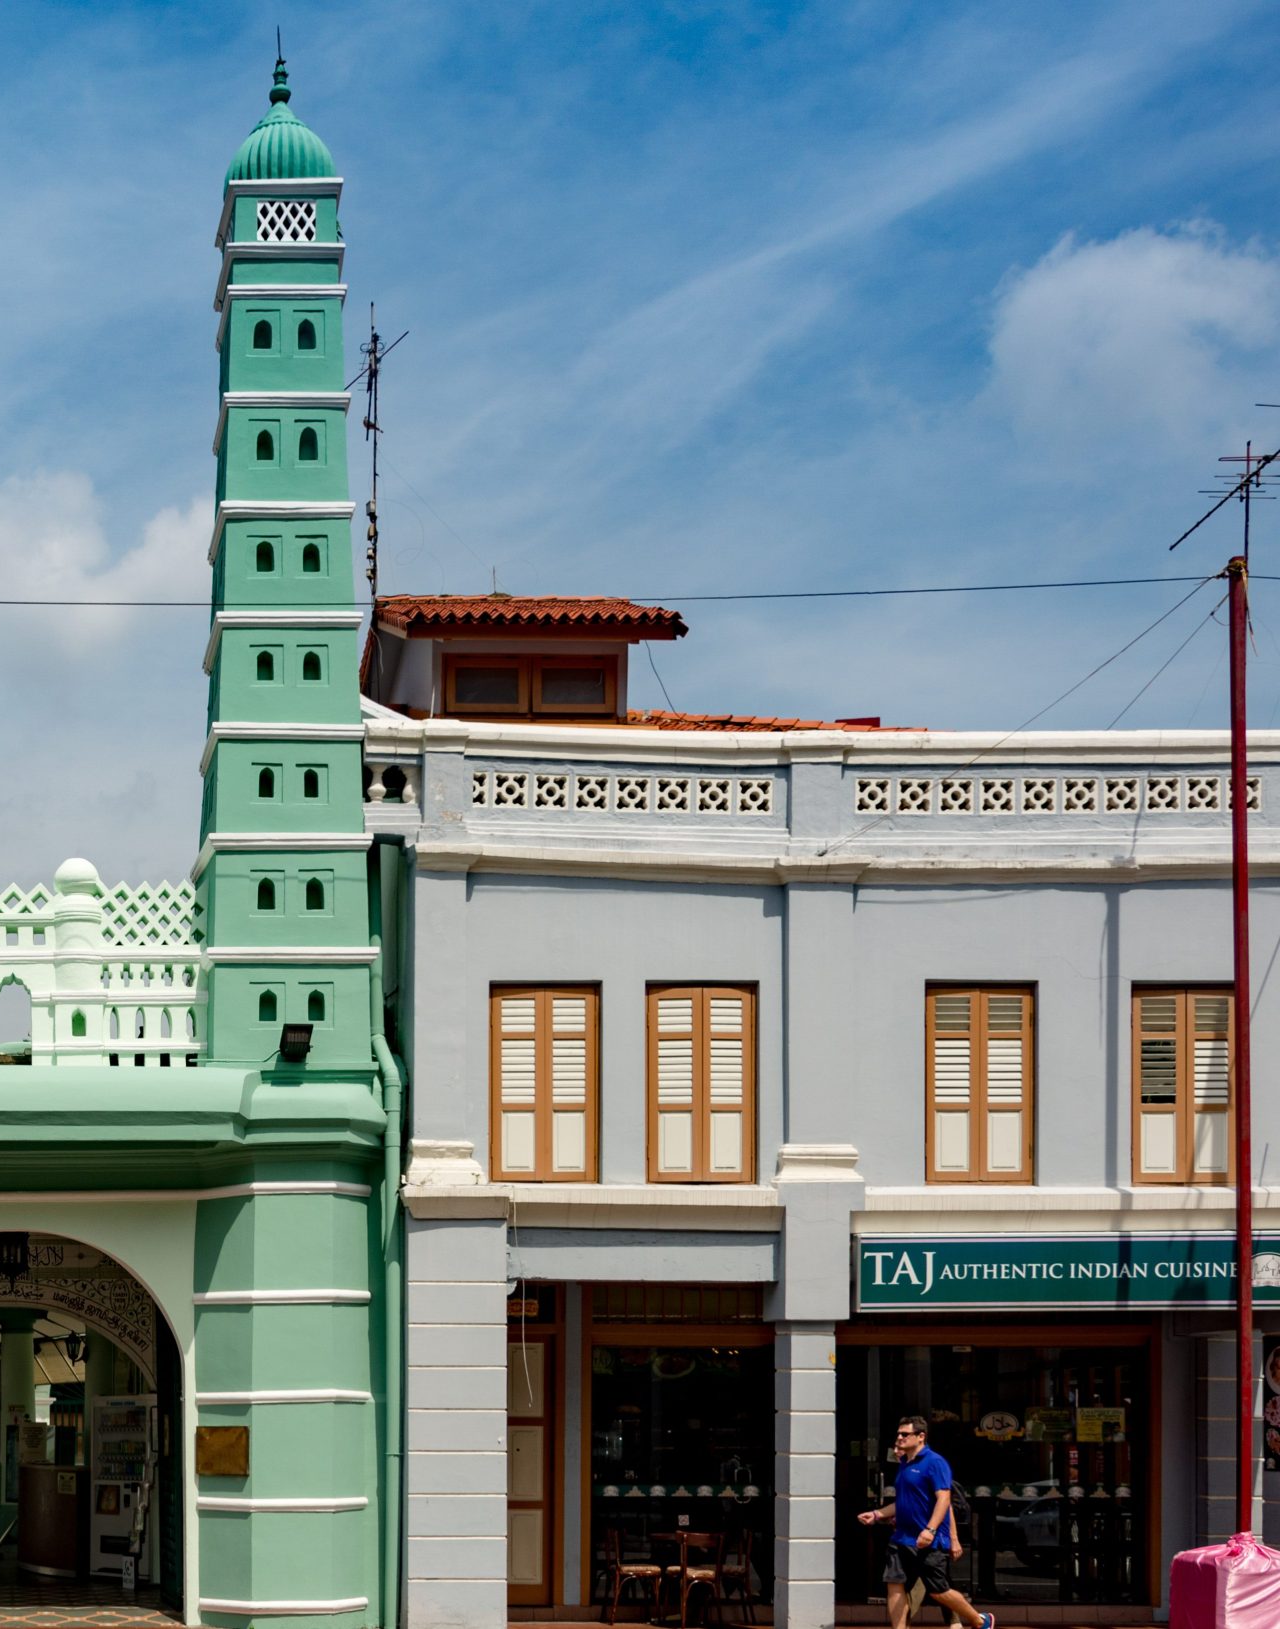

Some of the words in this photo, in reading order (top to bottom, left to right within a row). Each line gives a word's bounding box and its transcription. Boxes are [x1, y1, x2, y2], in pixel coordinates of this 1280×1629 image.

[863, 1251, 937, 1295] TAJ
[939, 1262, 1063, 1280] AUTHENTIC
[1069, 1261, 1148, 1279] INDIAN
[1154, 1261, 1238, 1279] CUISINE
